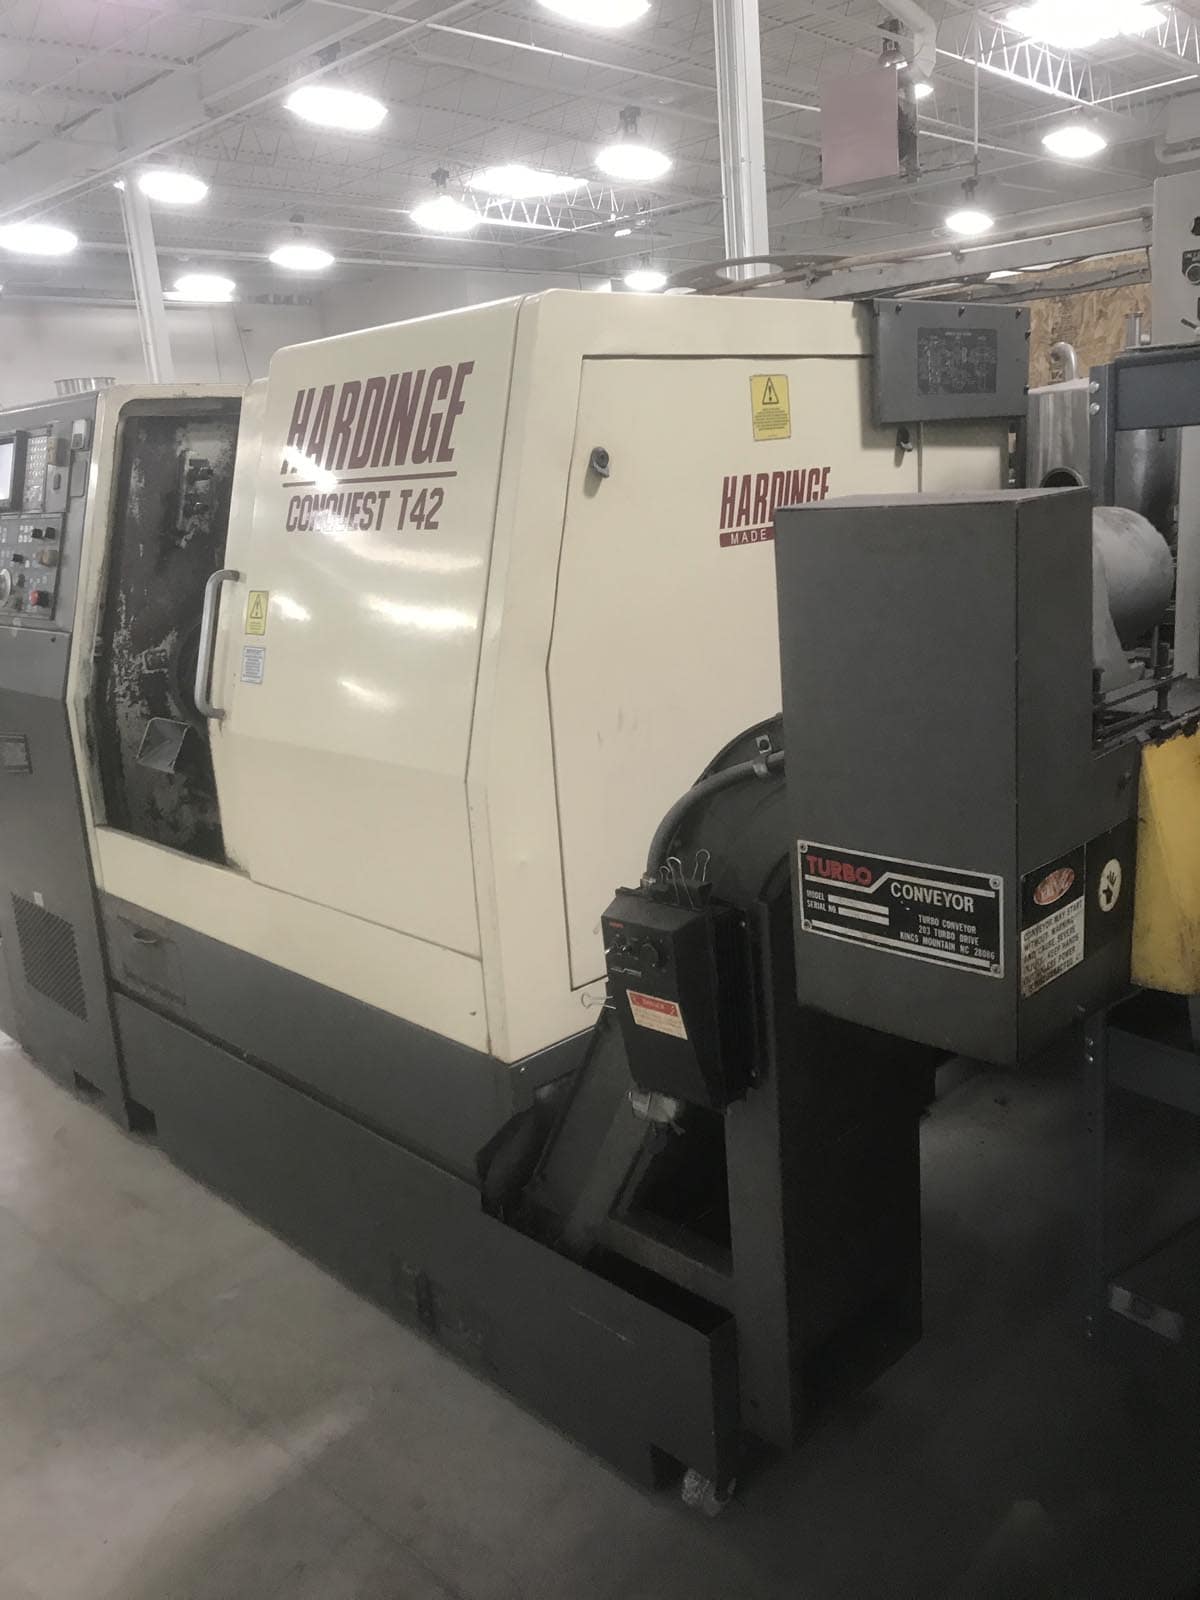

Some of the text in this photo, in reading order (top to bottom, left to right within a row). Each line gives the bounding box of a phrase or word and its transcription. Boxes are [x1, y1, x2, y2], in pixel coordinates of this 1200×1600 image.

[280, 360, 475, 475] HARDINGE
[719, 466, 831, 529] HARDINGE
[397, 487, 445, 531] T42
[730, 529, 768, 545] MADE
[806, 855, 872, 886] TURBO
[806, 889, 825, 901] MODEL
[806, 899, 827, 912] SERIAL
[890, 881, 975, 913] CONVEYOR
[918, 913, 977, 935] TURBO CONVEYOR
[899, 930, 919, 943] KINGS
[922, 935, 956, 952] MOUNTAIN
[933, 927, 956, 941] TURBO
[959, 933, 980, 946] DRIVE
